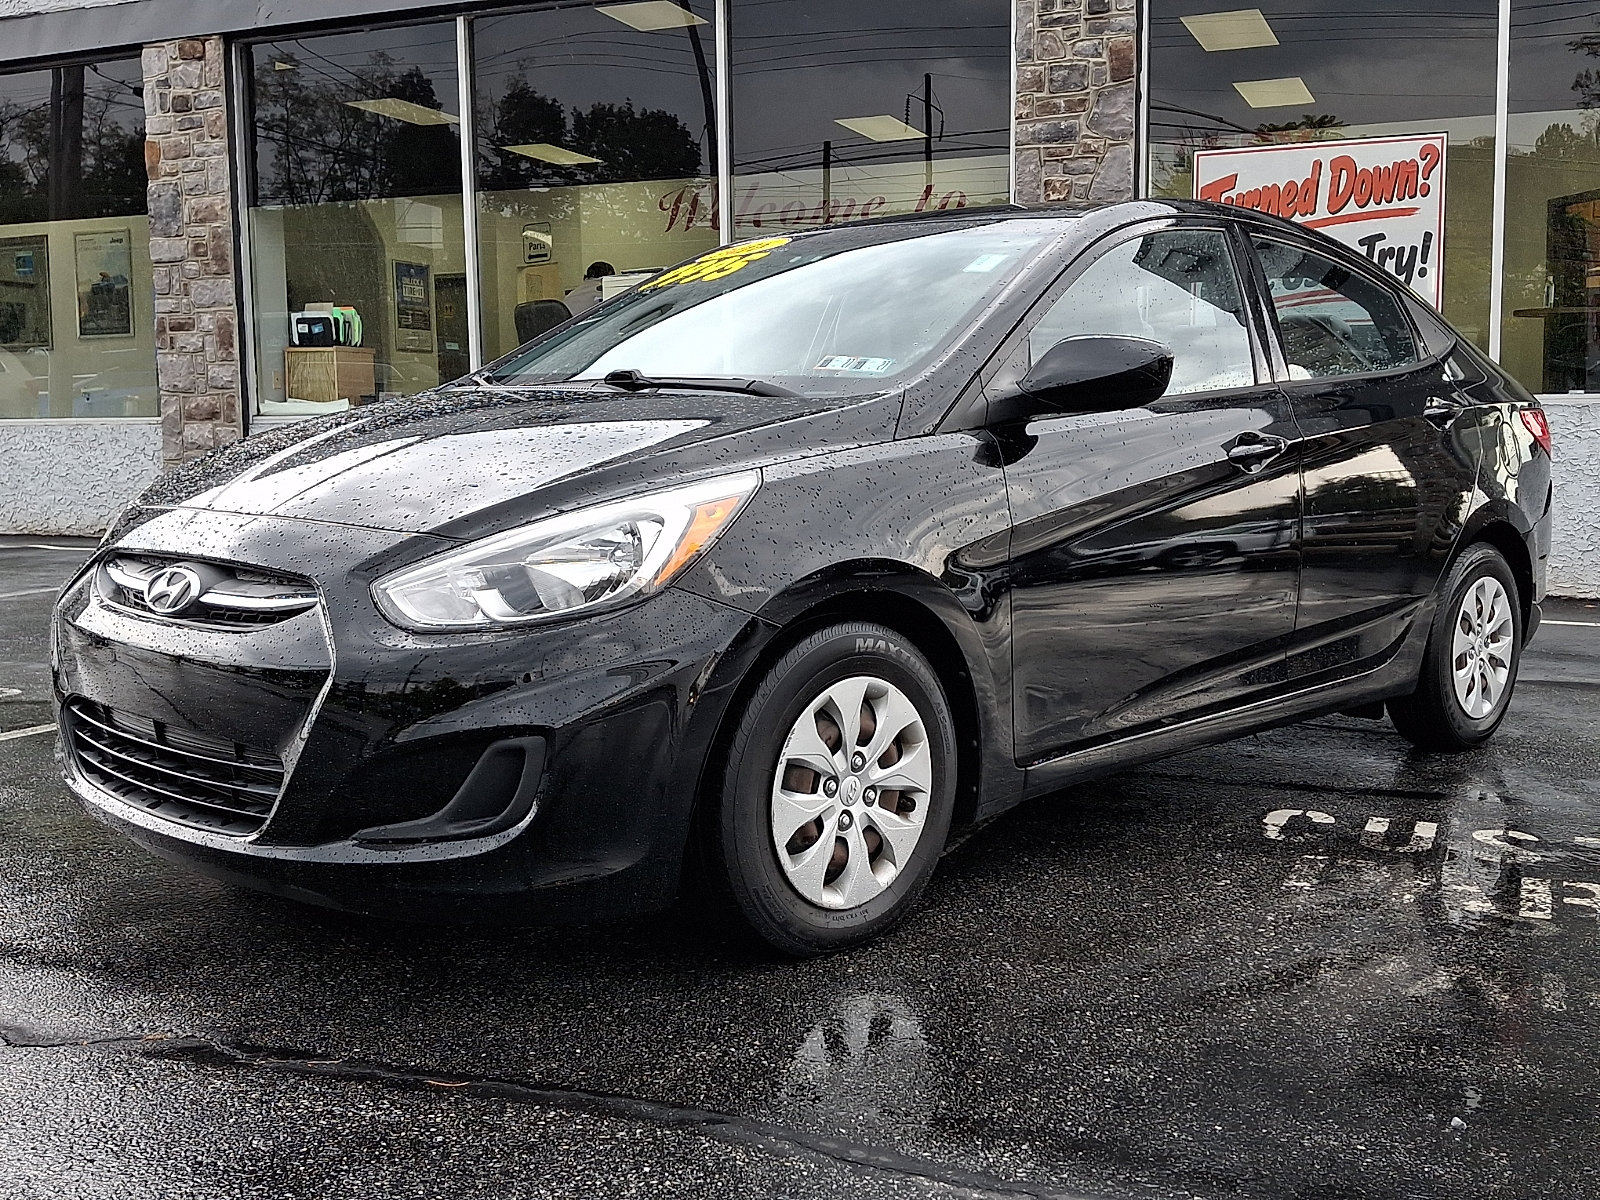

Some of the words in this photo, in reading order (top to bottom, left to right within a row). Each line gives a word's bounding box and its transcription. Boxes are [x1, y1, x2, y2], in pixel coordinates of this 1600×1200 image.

[914, 184, 967, 212] to
[1327, 143, 1441, 215] Down?
[528, 242, 546, 250] Parts
[1358, 231, 1433, 285] Try!
[1261, 808, 1600, 863] CUS
